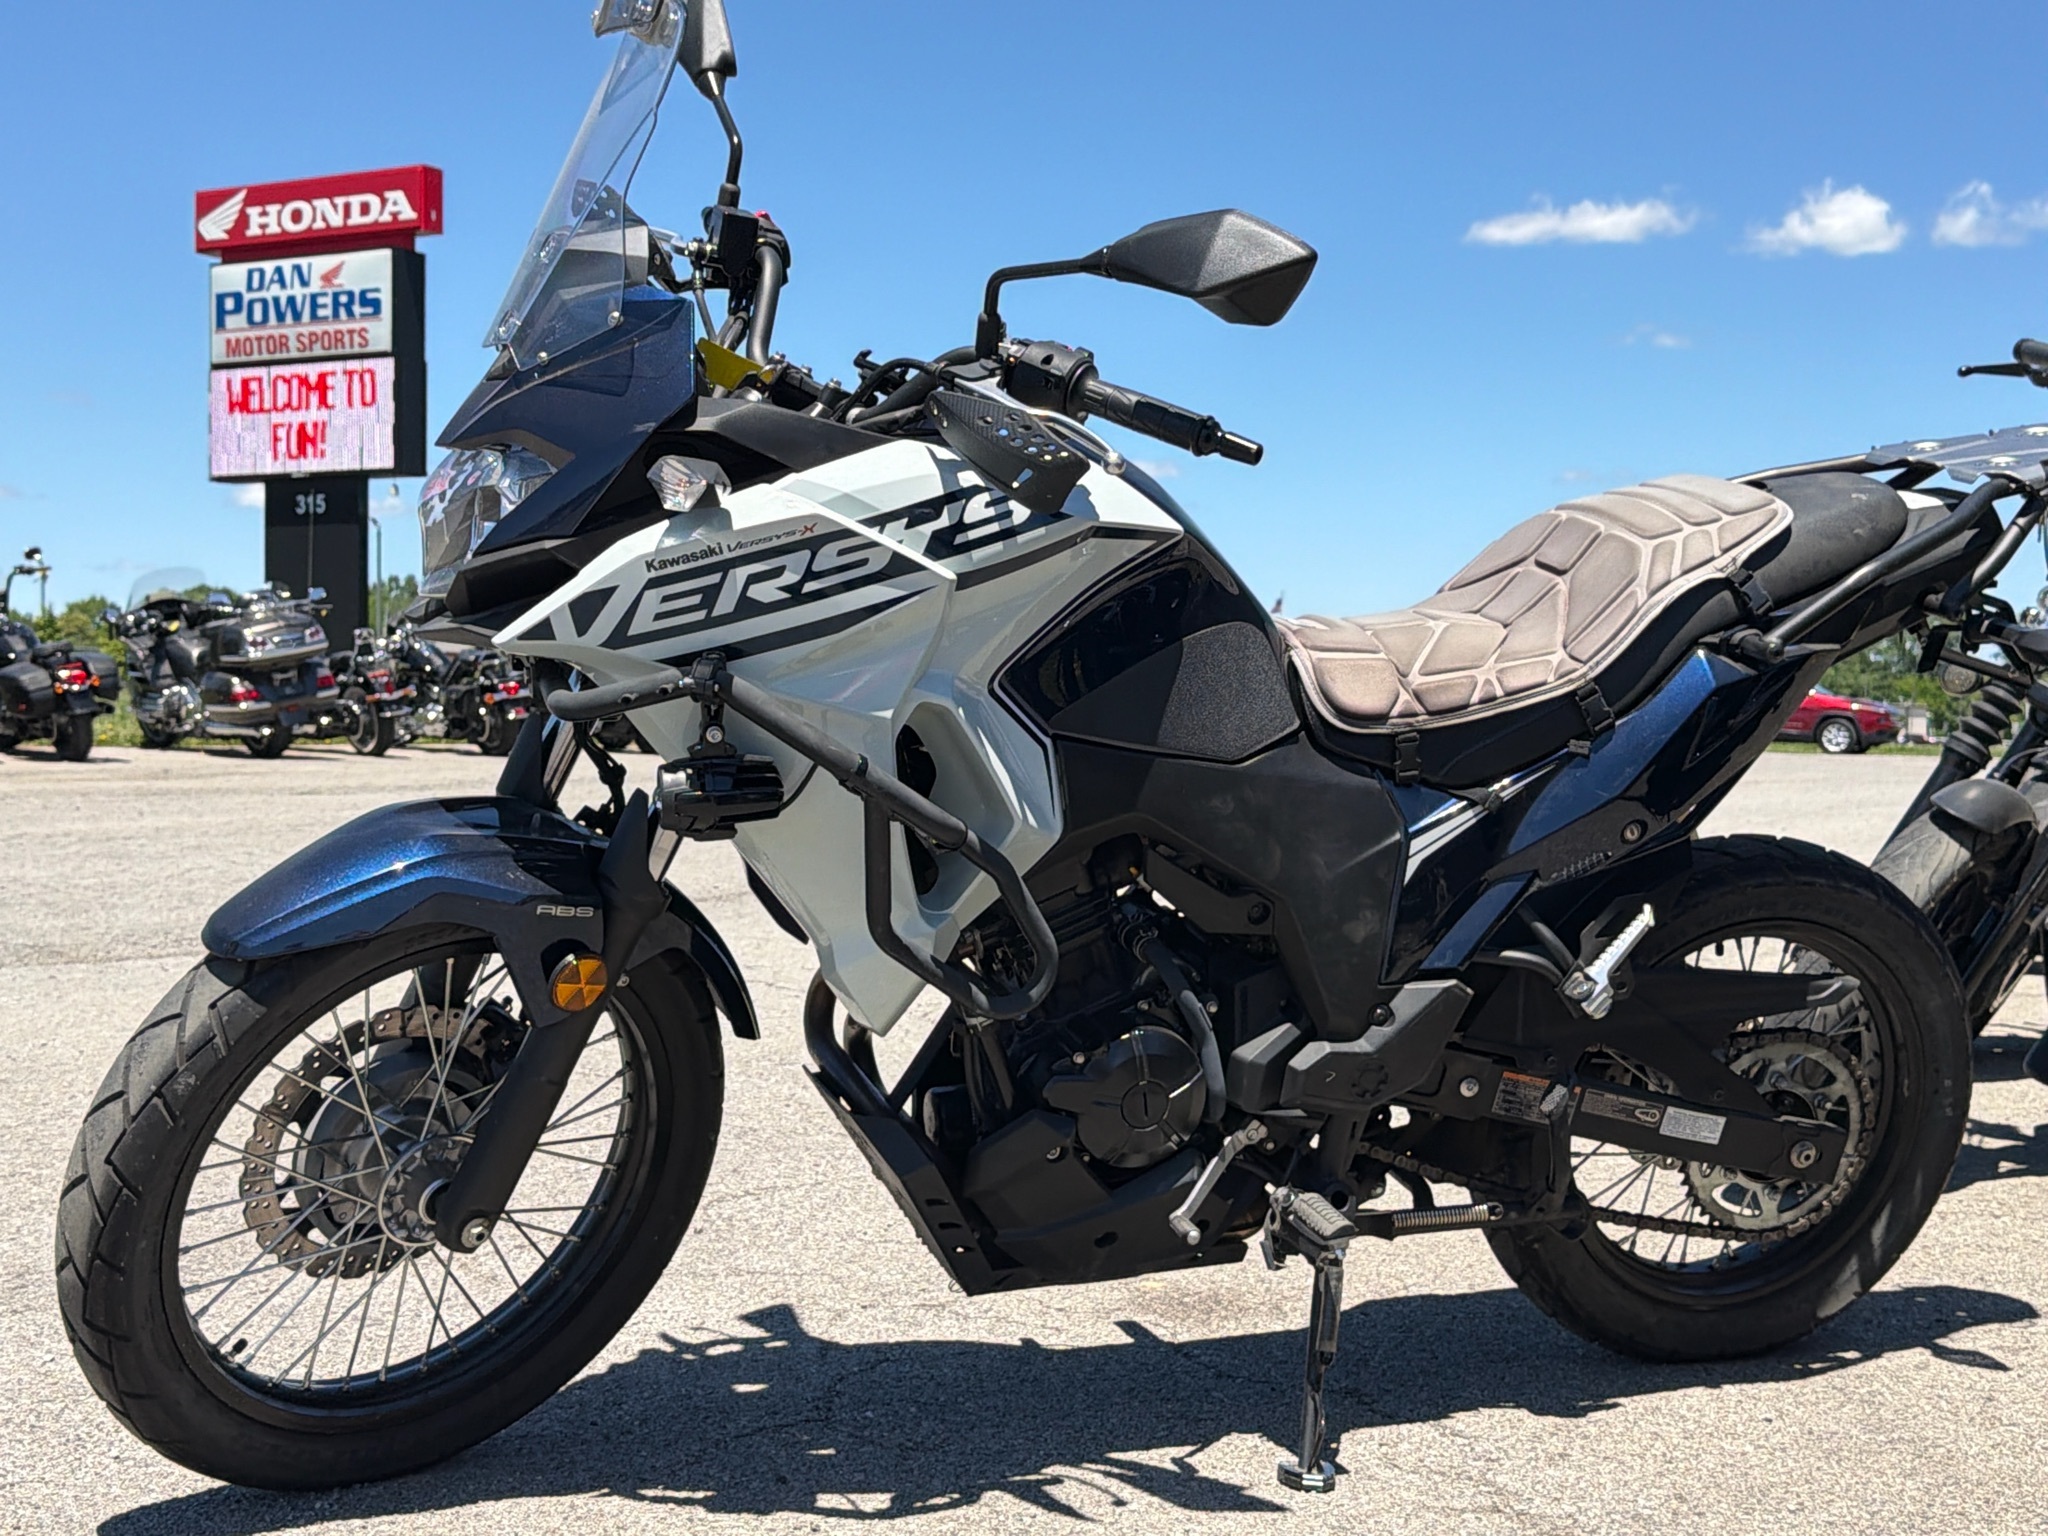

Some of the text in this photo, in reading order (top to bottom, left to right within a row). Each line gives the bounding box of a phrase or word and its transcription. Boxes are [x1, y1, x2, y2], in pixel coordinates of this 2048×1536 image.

[244, 189, 419, 237] HONDA
[245, 262, 312, 292] DAN
[215, 287, 383, 329] POWERS
[225, 327, 370, 359] MOTOR SPORTS
[226, 367, 378, 415] WELCOME TO
[271, 420, 328, 463] FUN!
[294, 493, 327, 515] 315
[644, 522, 818, 573] Kawasaki VERSYS-X
[536, 904, 595, 917] ABS
